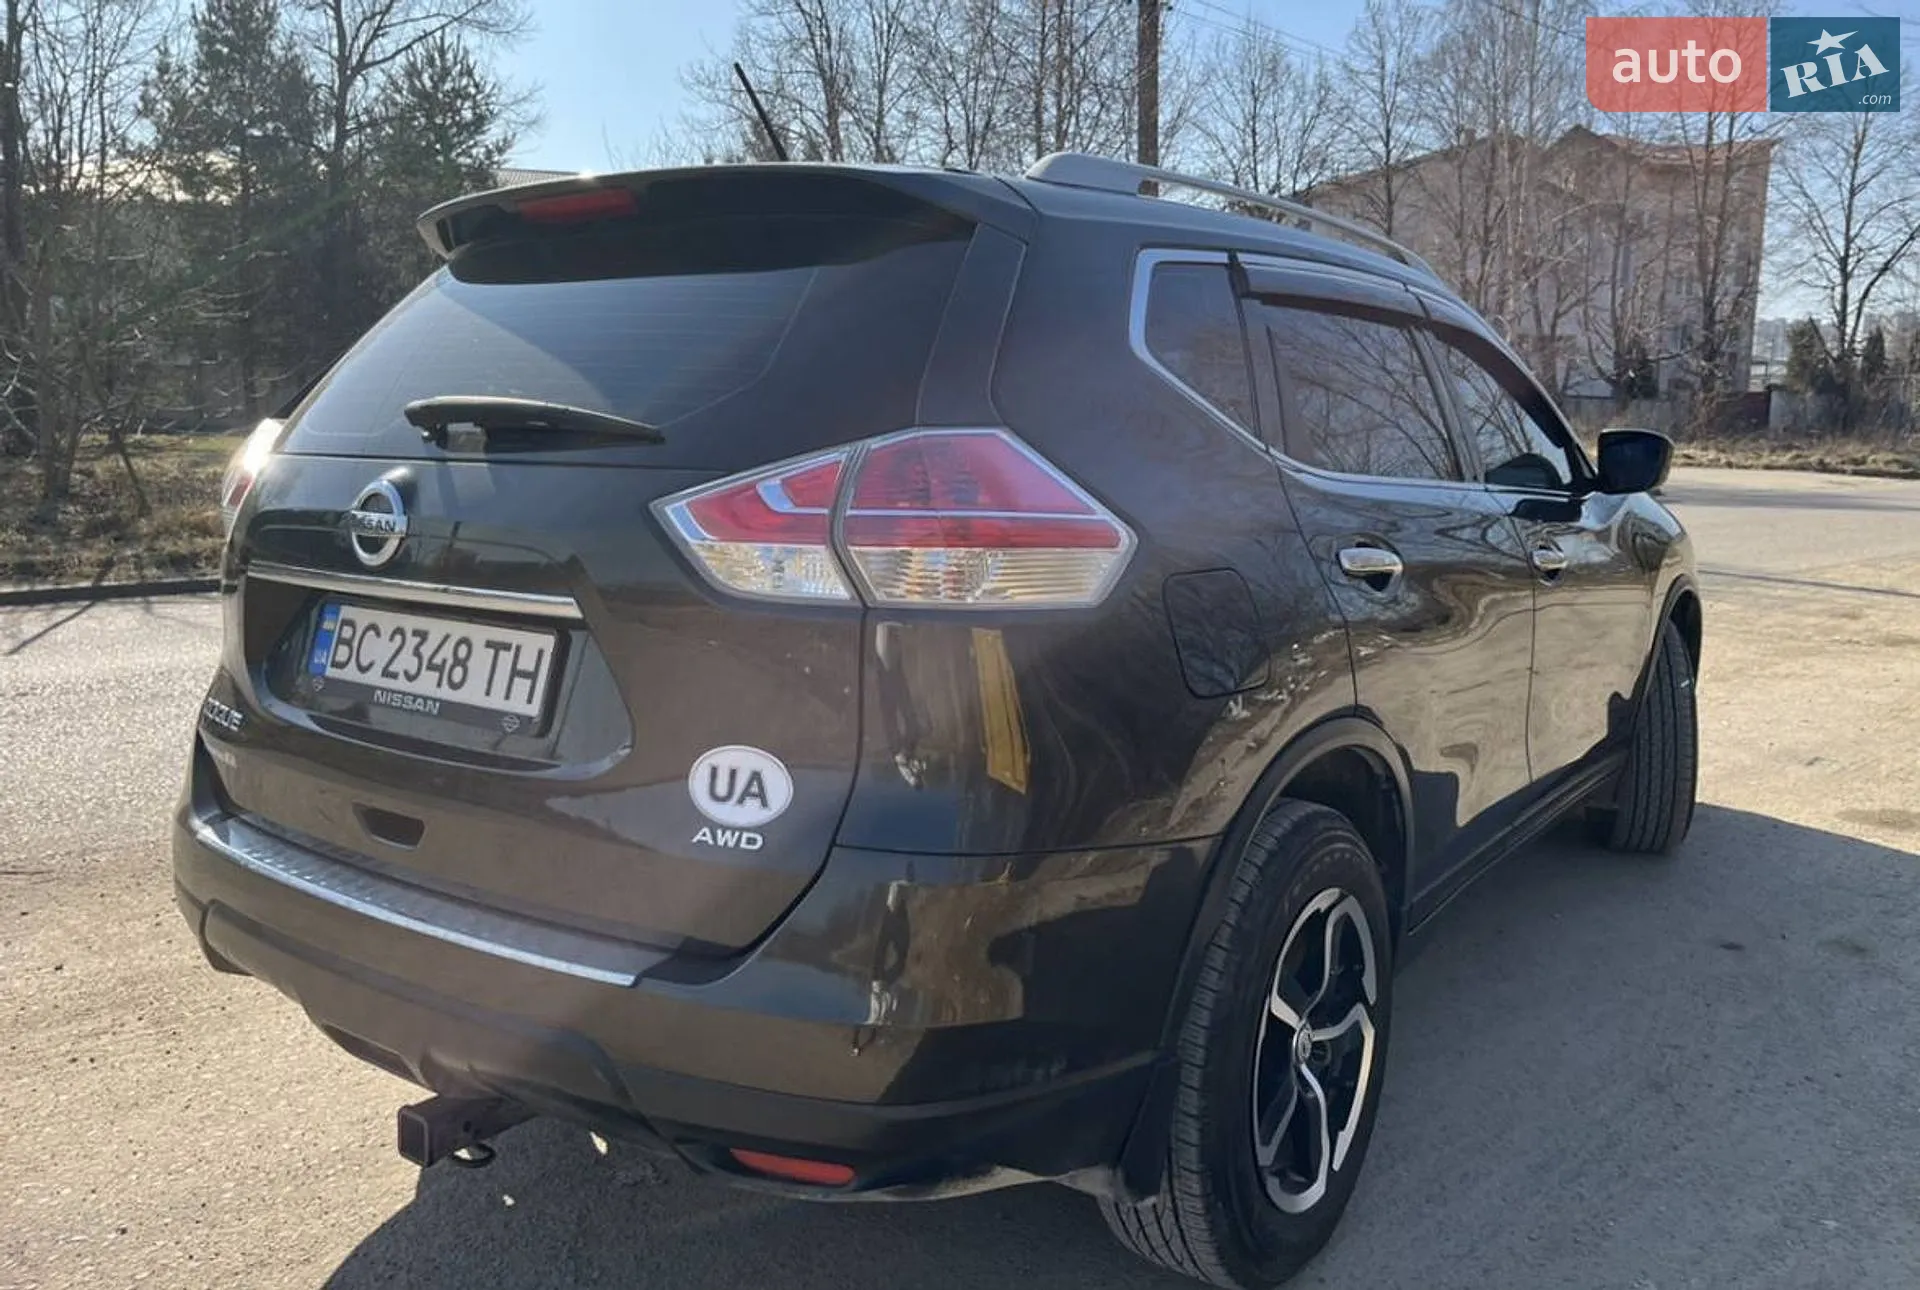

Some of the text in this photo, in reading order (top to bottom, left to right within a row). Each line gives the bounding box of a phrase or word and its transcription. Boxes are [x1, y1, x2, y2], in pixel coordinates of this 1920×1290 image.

[485, 639, 545, 705] TH
[373, 689, 441, 716] NISSAN
[708, 765, 769, 809] UA
[691, 826, 764, 850] AWD
